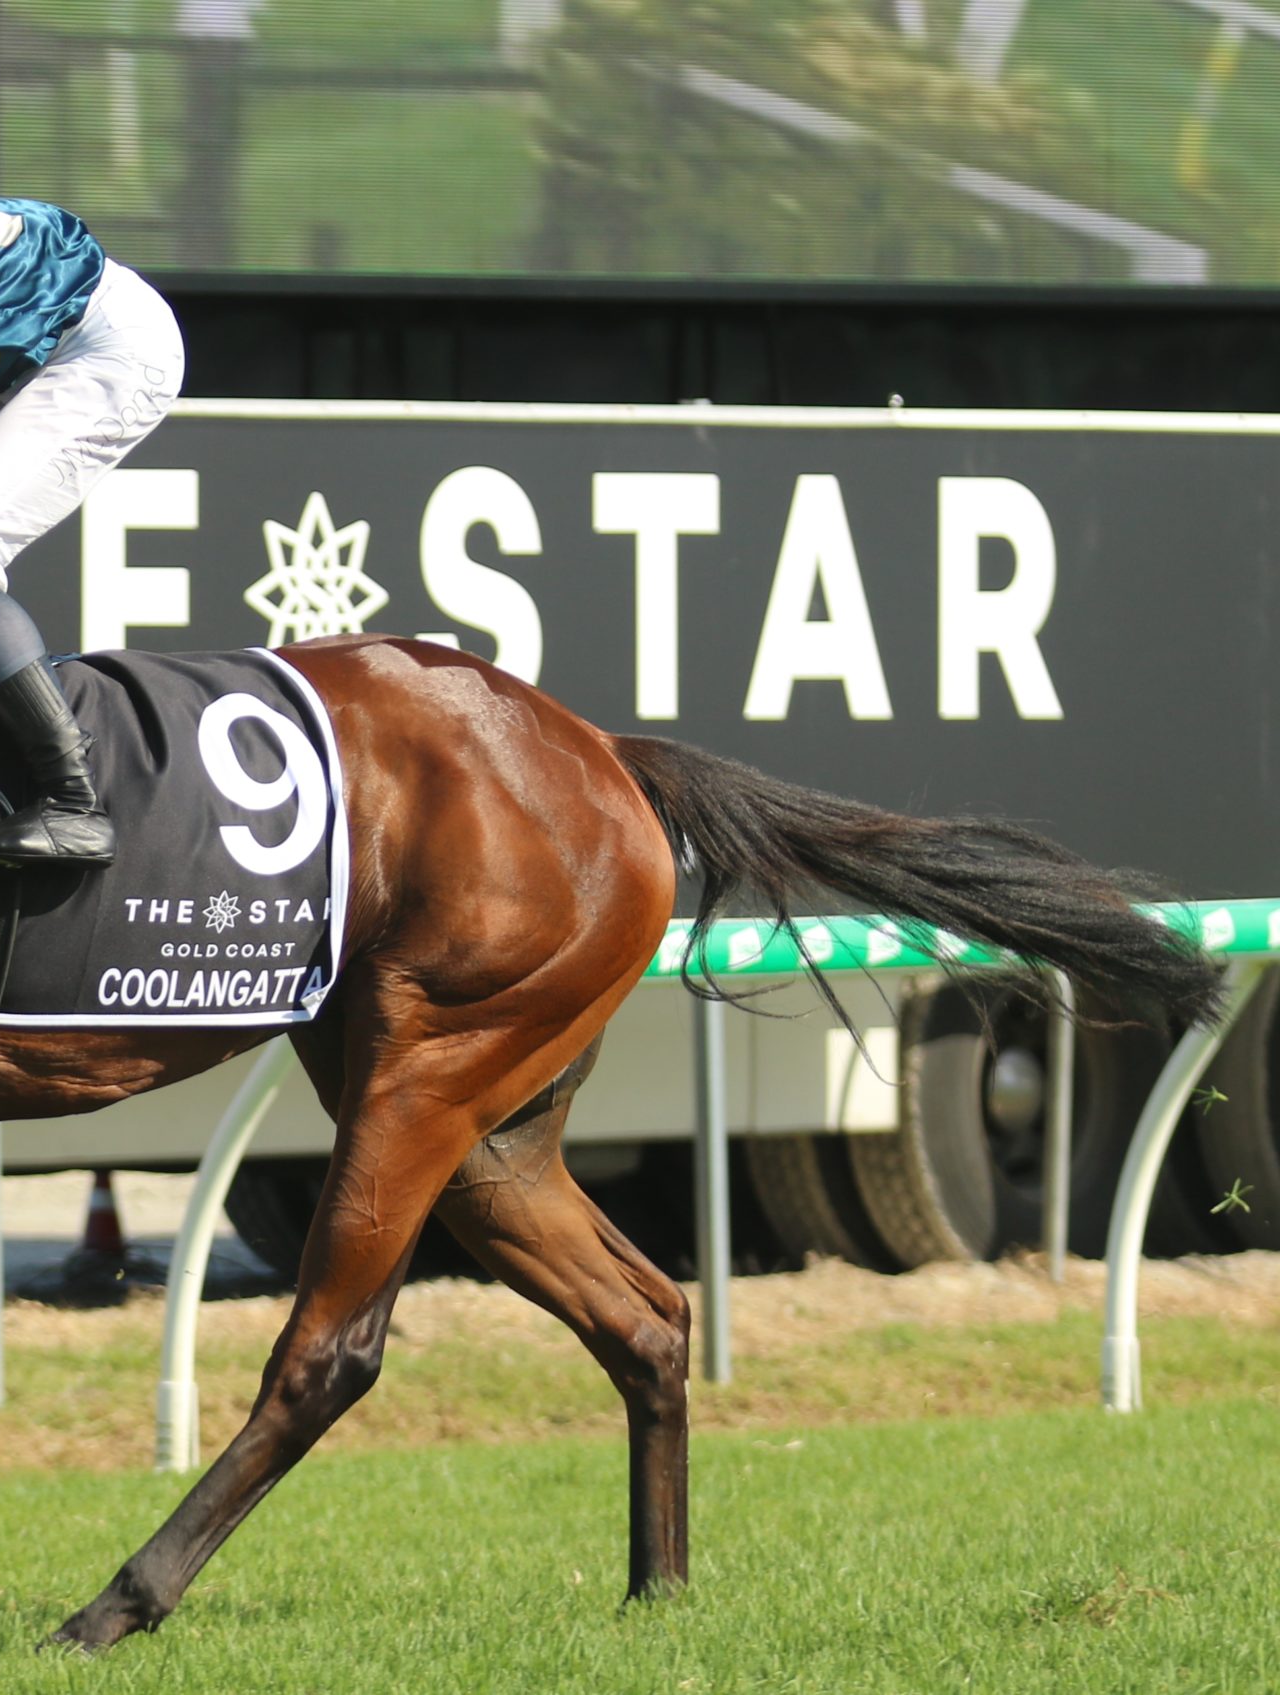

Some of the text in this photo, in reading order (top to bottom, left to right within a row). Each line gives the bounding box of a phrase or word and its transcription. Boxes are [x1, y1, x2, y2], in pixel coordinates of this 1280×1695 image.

[420, 465, 1065, 721] STAR
[198, 692, 327, 875] 9
[125, 897, 331, 924] THE STA
[161, 942, 296, 958] GOLD COAST
[98, 966, 322, 1008] COOLANGATTA
